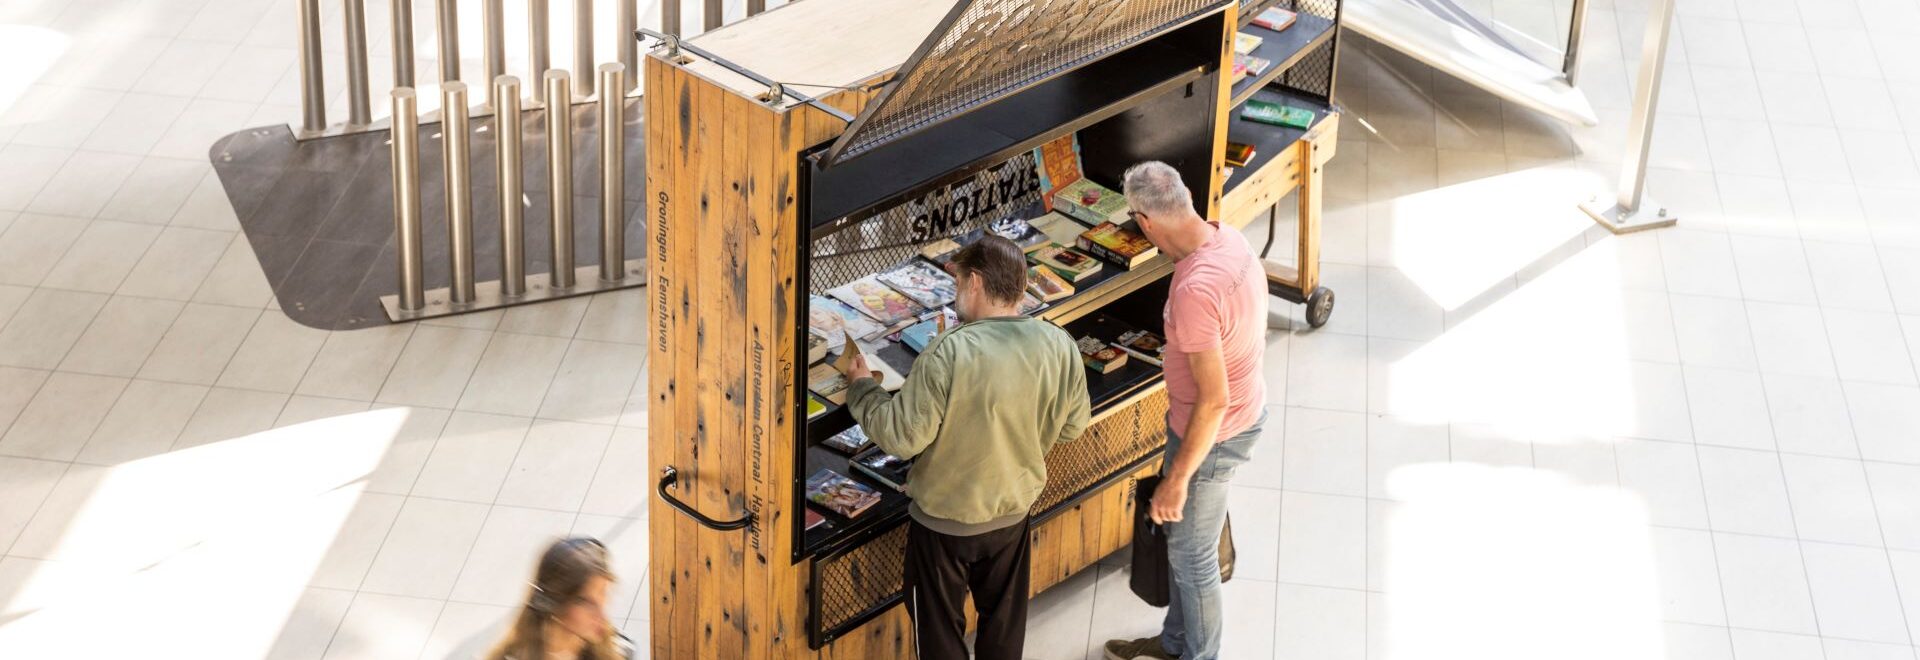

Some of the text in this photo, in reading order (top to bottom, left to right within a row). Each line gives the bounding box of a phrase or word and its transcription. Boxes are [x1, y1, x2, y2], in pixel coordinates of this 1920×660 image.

[656, 190, 669, 263] Groningen
[659, 275, 669, 353] Eemshaven
[753, 340, 765, 421] Amsterdam
[752, 423, 764, 484] Centraal
[750, 493, 763, 550] Haarlem
